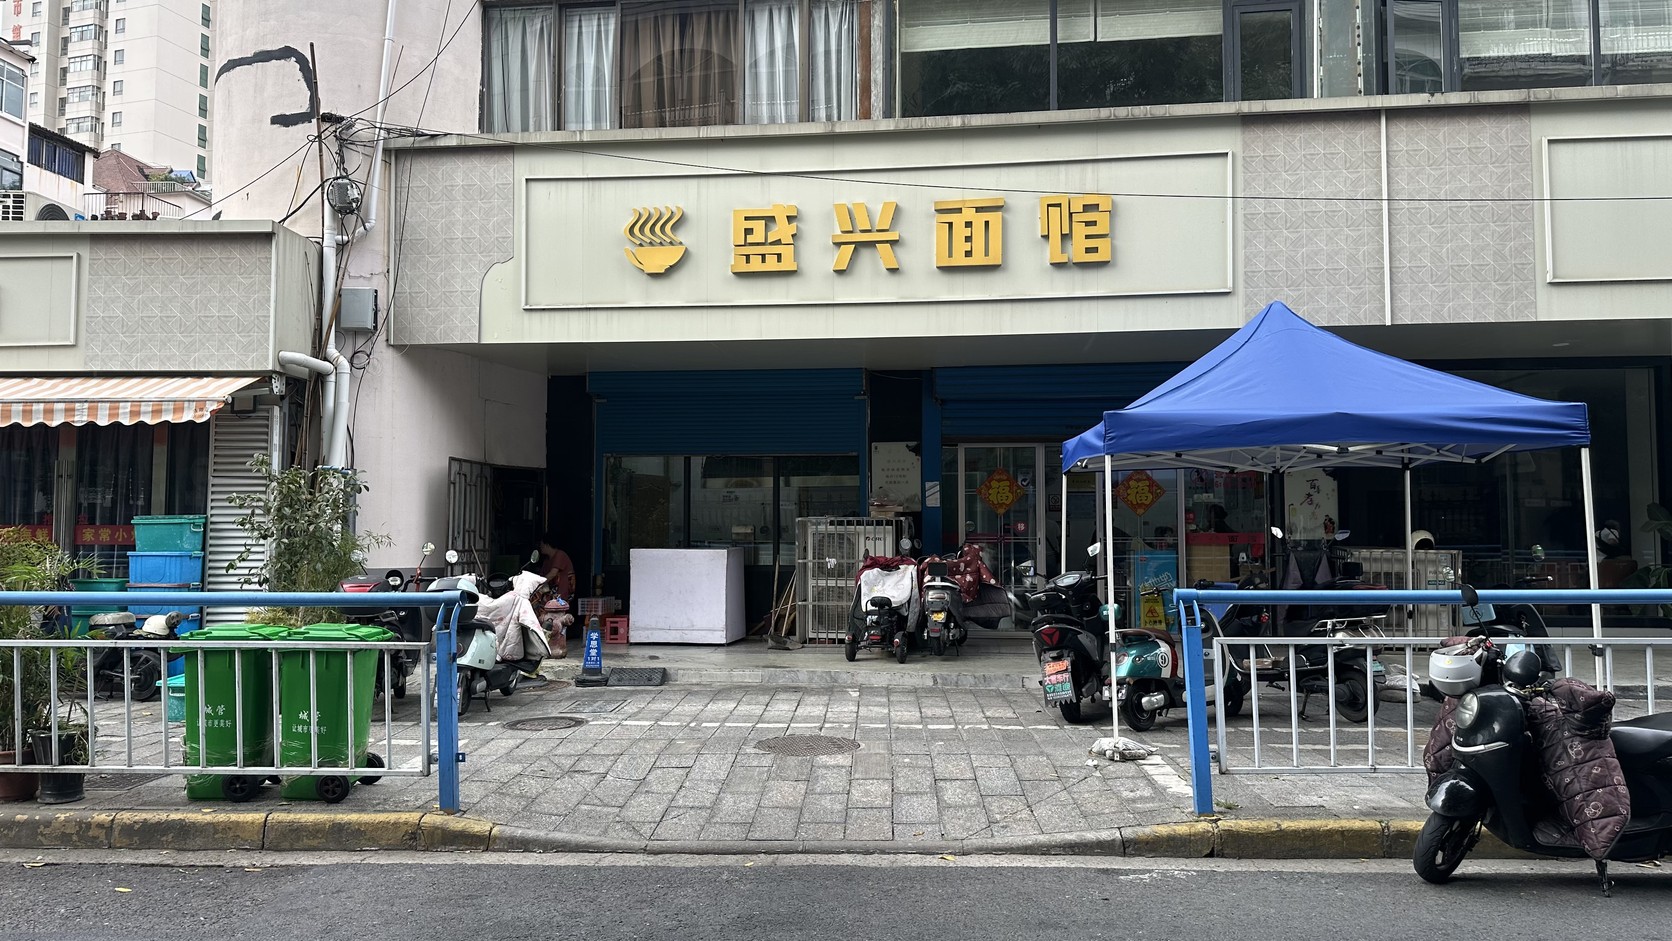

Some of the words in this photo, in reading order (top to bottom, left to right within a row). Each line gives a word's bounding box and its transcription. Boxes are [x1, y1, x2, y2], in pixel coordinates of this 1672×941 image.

[731, 194, 1113, 274] 盛兴面馆
[988, 480, 1013, 504] 福
[1127, 480, 1153, 504] 福
[82, 528, 135, 541] 家常小
